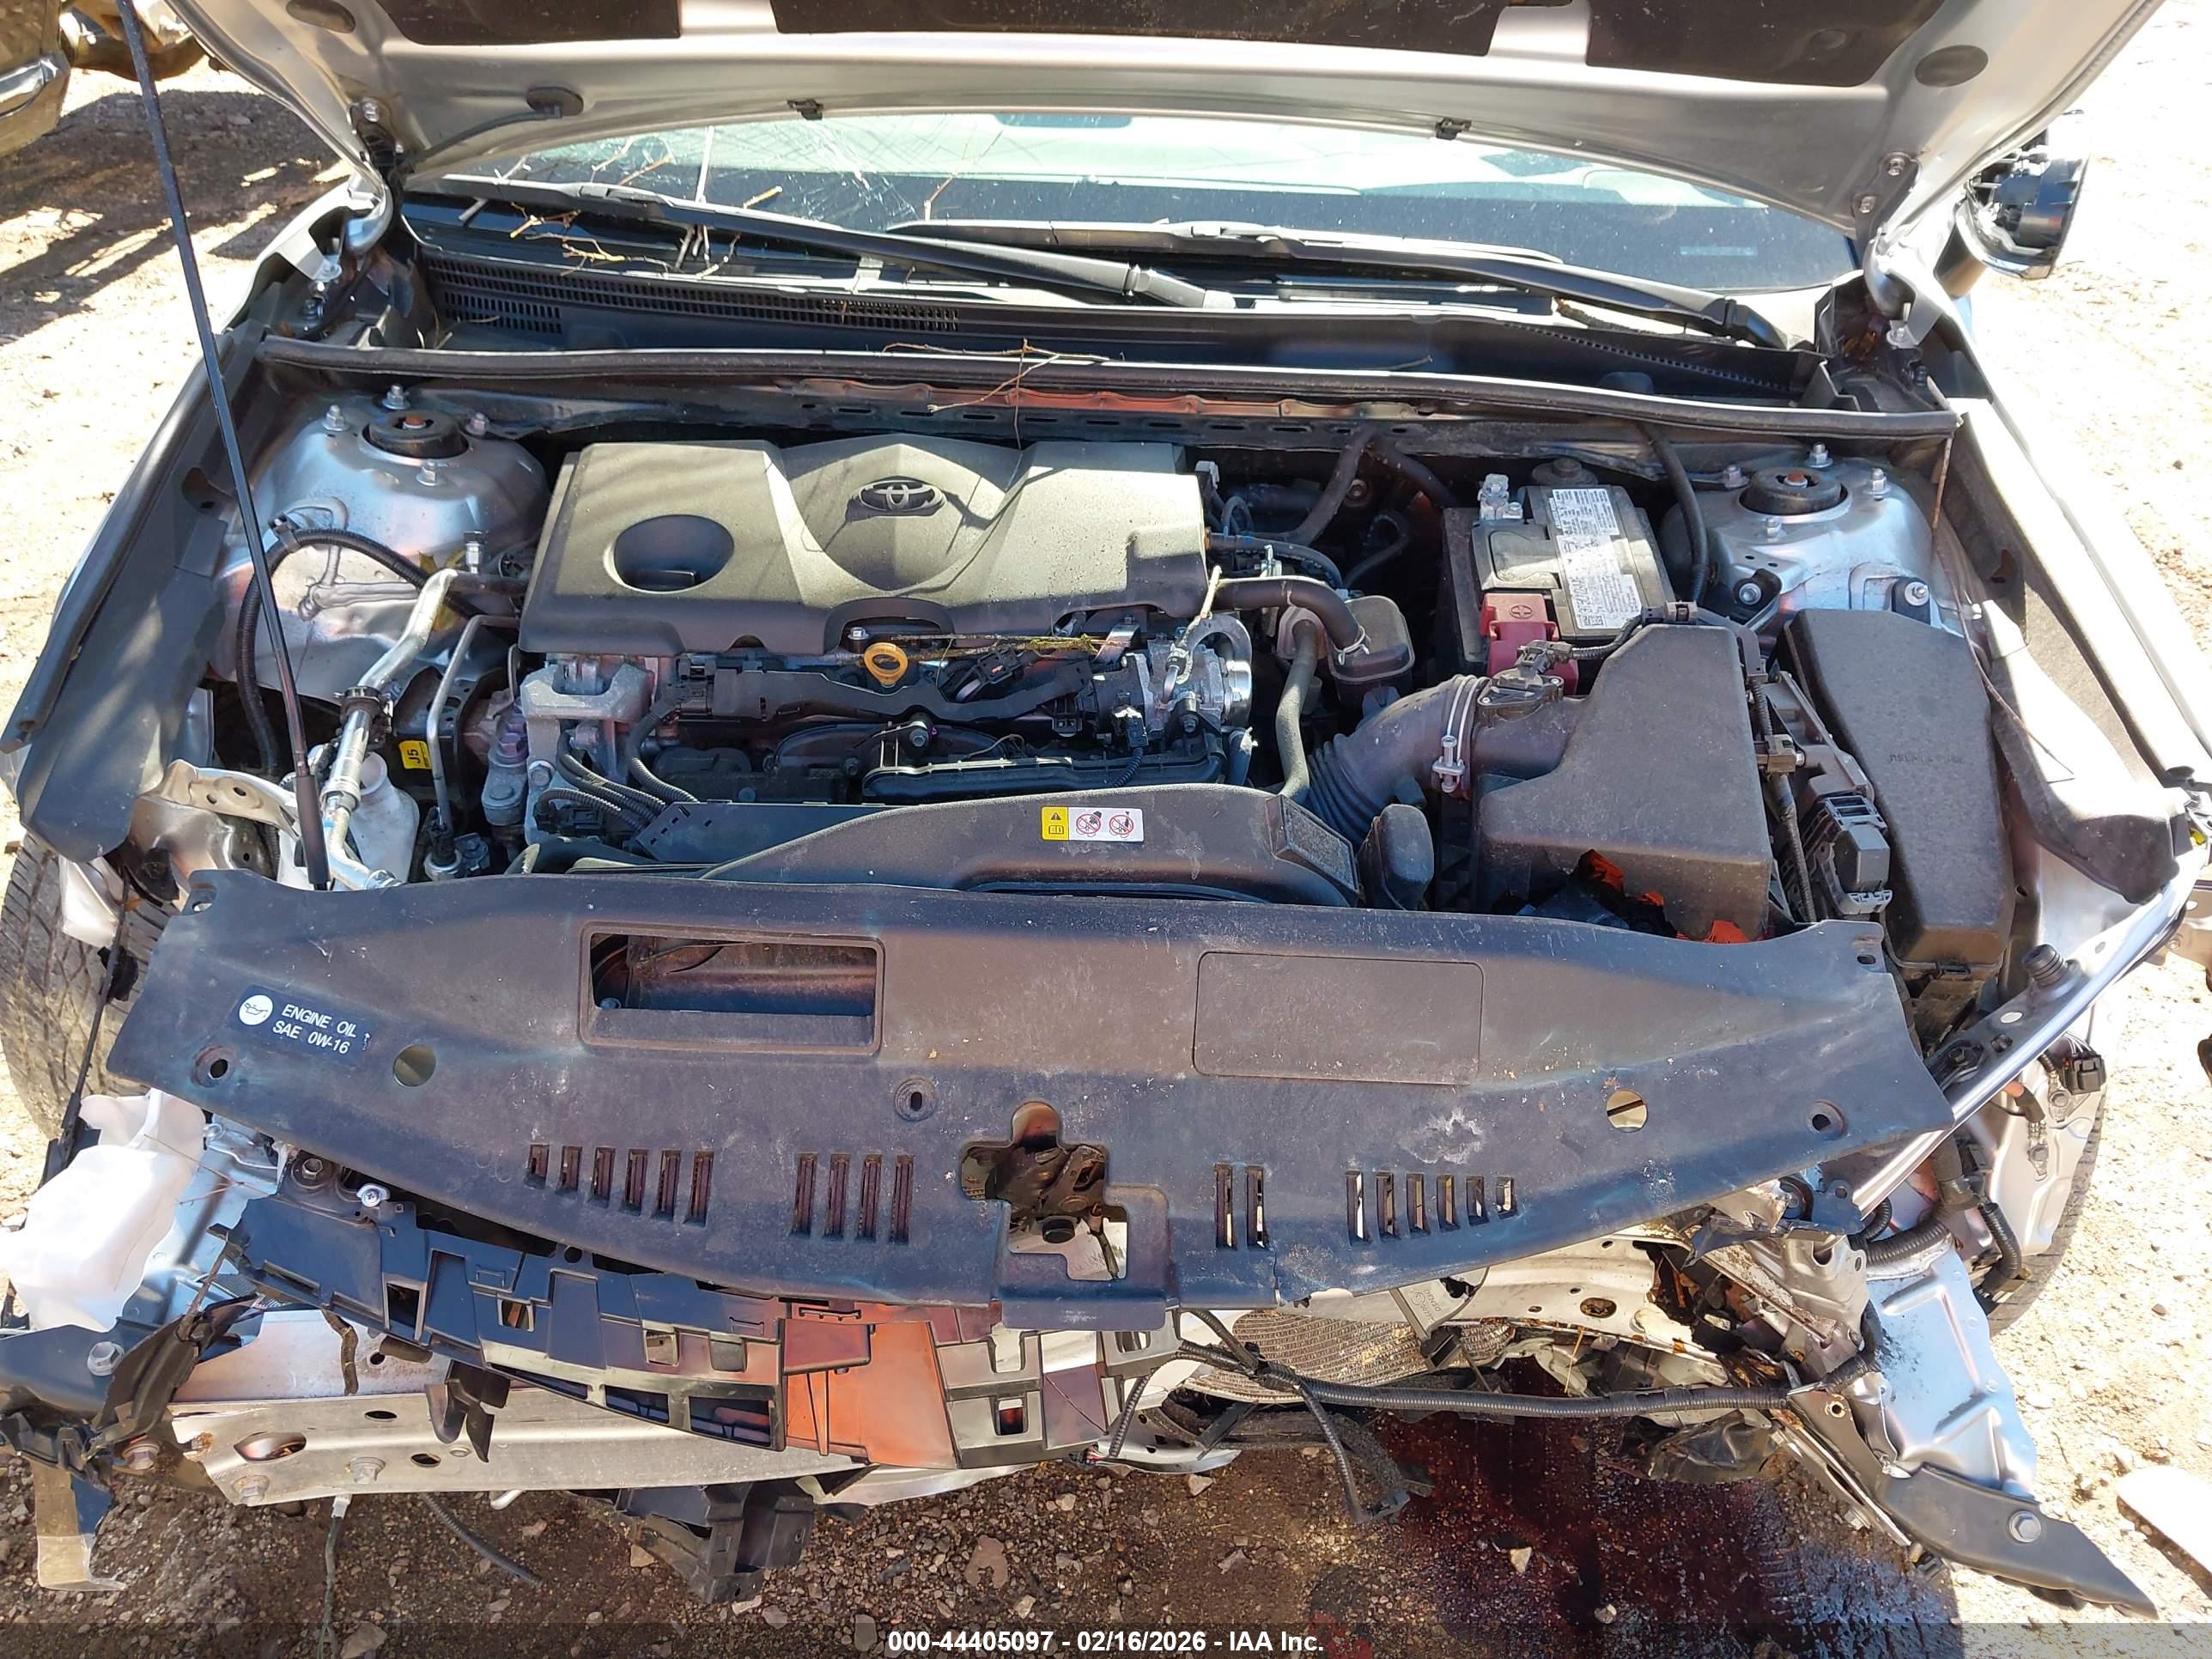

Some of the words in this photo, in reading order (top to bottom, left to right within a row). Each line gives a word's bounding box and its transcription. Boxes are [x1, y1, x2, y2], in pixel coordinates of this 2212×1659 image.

[407, 749, 421, 764] J5
[272, 1020, 303, 1039] SAE
[307, 1031, 350, 1054] 0W-16
[282, 1004, 332, 1029] ENGINE
[337, 1021, 357, 1038] OIL
